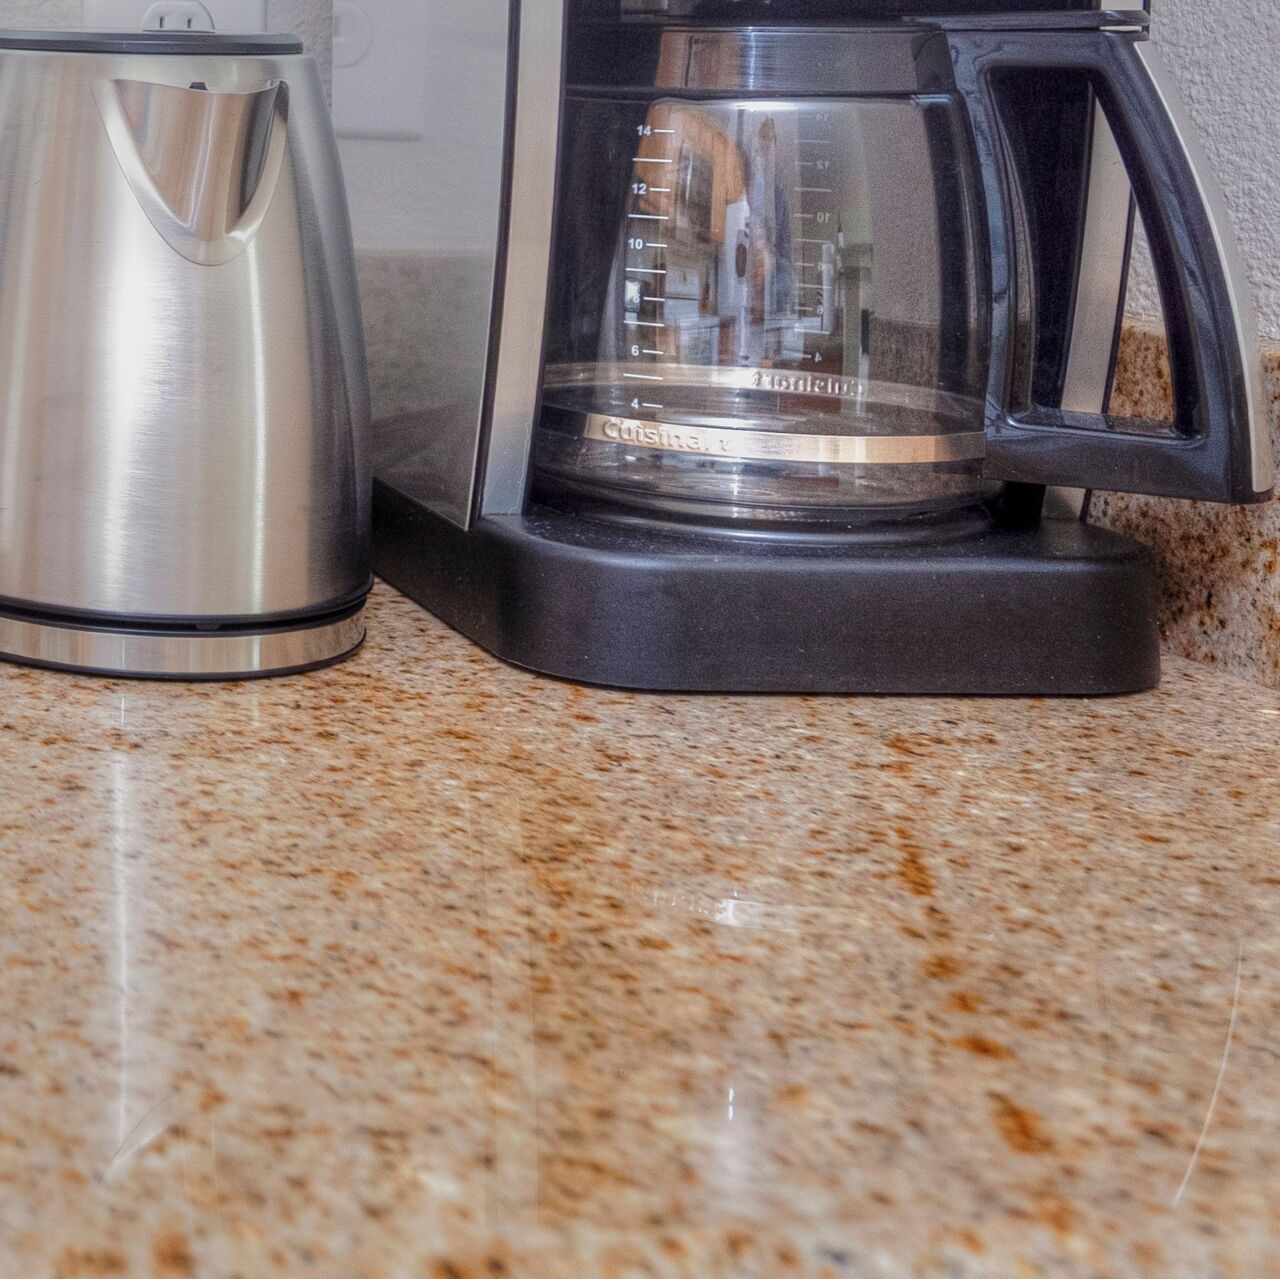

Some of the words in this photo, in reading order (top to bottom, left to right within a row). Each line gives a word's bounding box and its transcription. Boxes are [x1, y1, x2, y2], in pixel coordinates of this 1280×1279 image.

[636, 125, 652, 136] 14
[631, 183, 647, 195] 12
[627, 238, 643, 250] 10
[632, 292, 640, 303] 8
[631, 345, 640, 356] 6
[630, 398, 640, 410] 4
